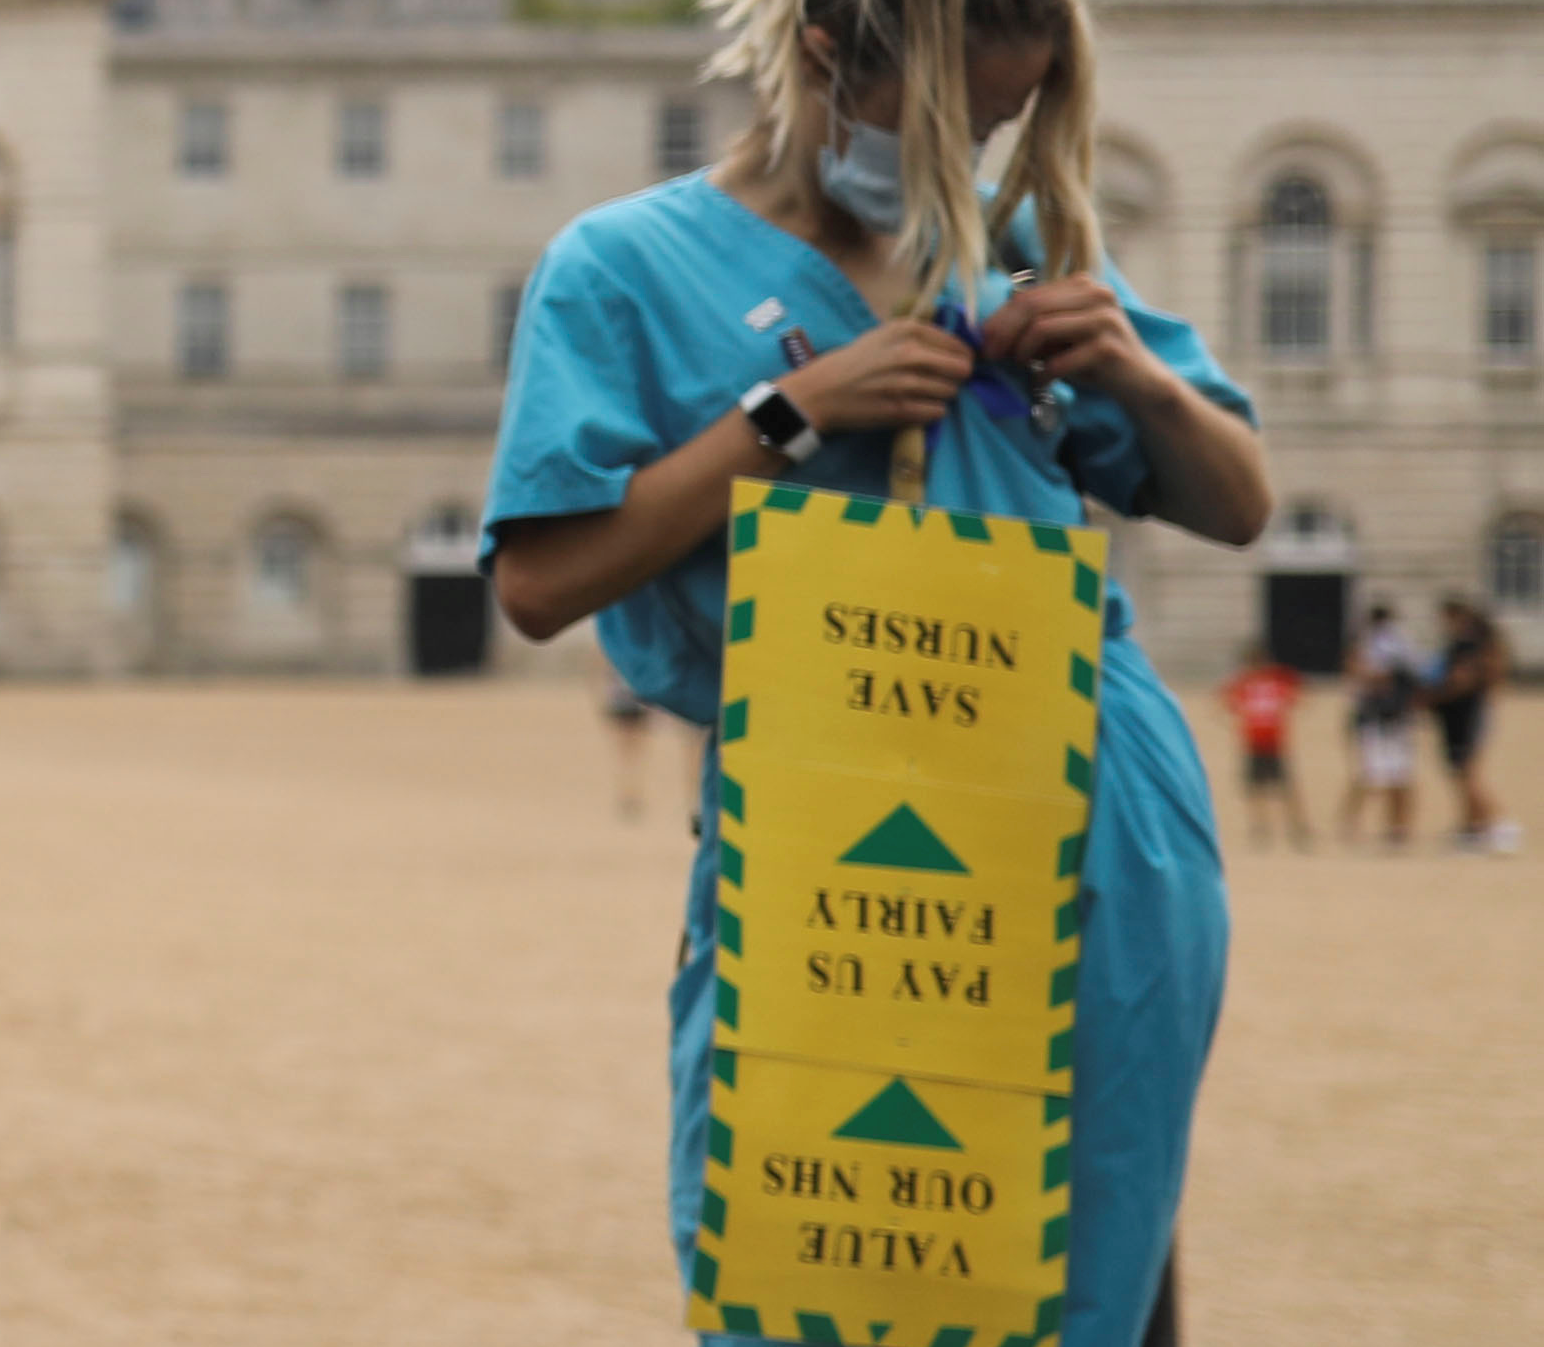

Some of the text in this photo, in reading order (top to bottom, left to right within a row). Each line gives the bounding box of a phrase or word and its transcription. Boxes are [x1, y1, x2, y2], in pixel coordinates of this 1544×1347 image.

[823, 603, 1018, 671] NURSES
[848, 669, 980, 727] SAVE
[806, 888, 996, 944] FAIRLY
[807, 950, 992, 1007] PAY US
[762, 1151, 994, 1215] OUR NHS
[798, 1221, 974, 1277] VALUE
